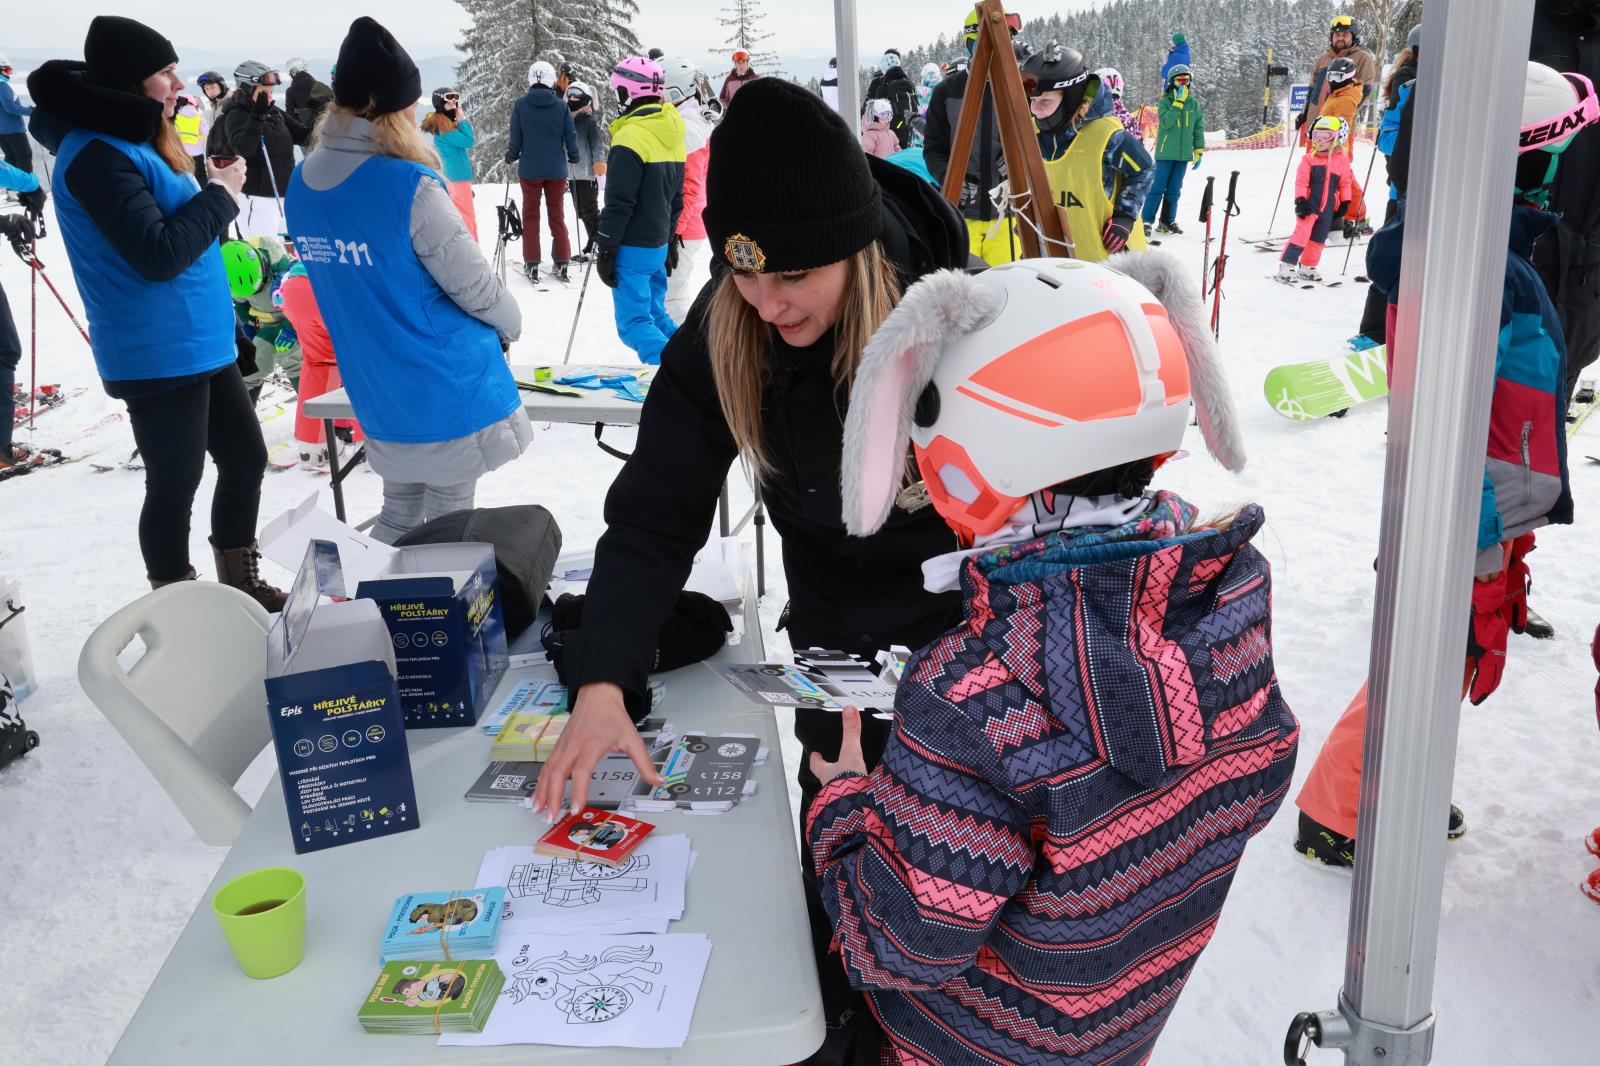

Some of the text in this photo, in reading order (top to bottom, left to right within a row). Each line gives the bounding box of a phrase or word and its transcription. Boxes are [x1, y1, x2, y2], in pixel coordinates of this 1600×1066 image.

[334, 239, 374, 266] 211
[390, 602, 425, 611] HŘEJIVÉ
[400, 608, 449, 617] POLŠTÁŘKY
[313, 694, 357, 711] HŘEJIVÉ
[326, 698, 386, 716] POLŠTÁŘKY
[601, 771, 635, 781] 158
[713, 771, 742, 780] 158
[706, 786, 736, 796] 112
[519, 944, 531, 956] 158
[574, 991, 590, 1017] POLICIE
